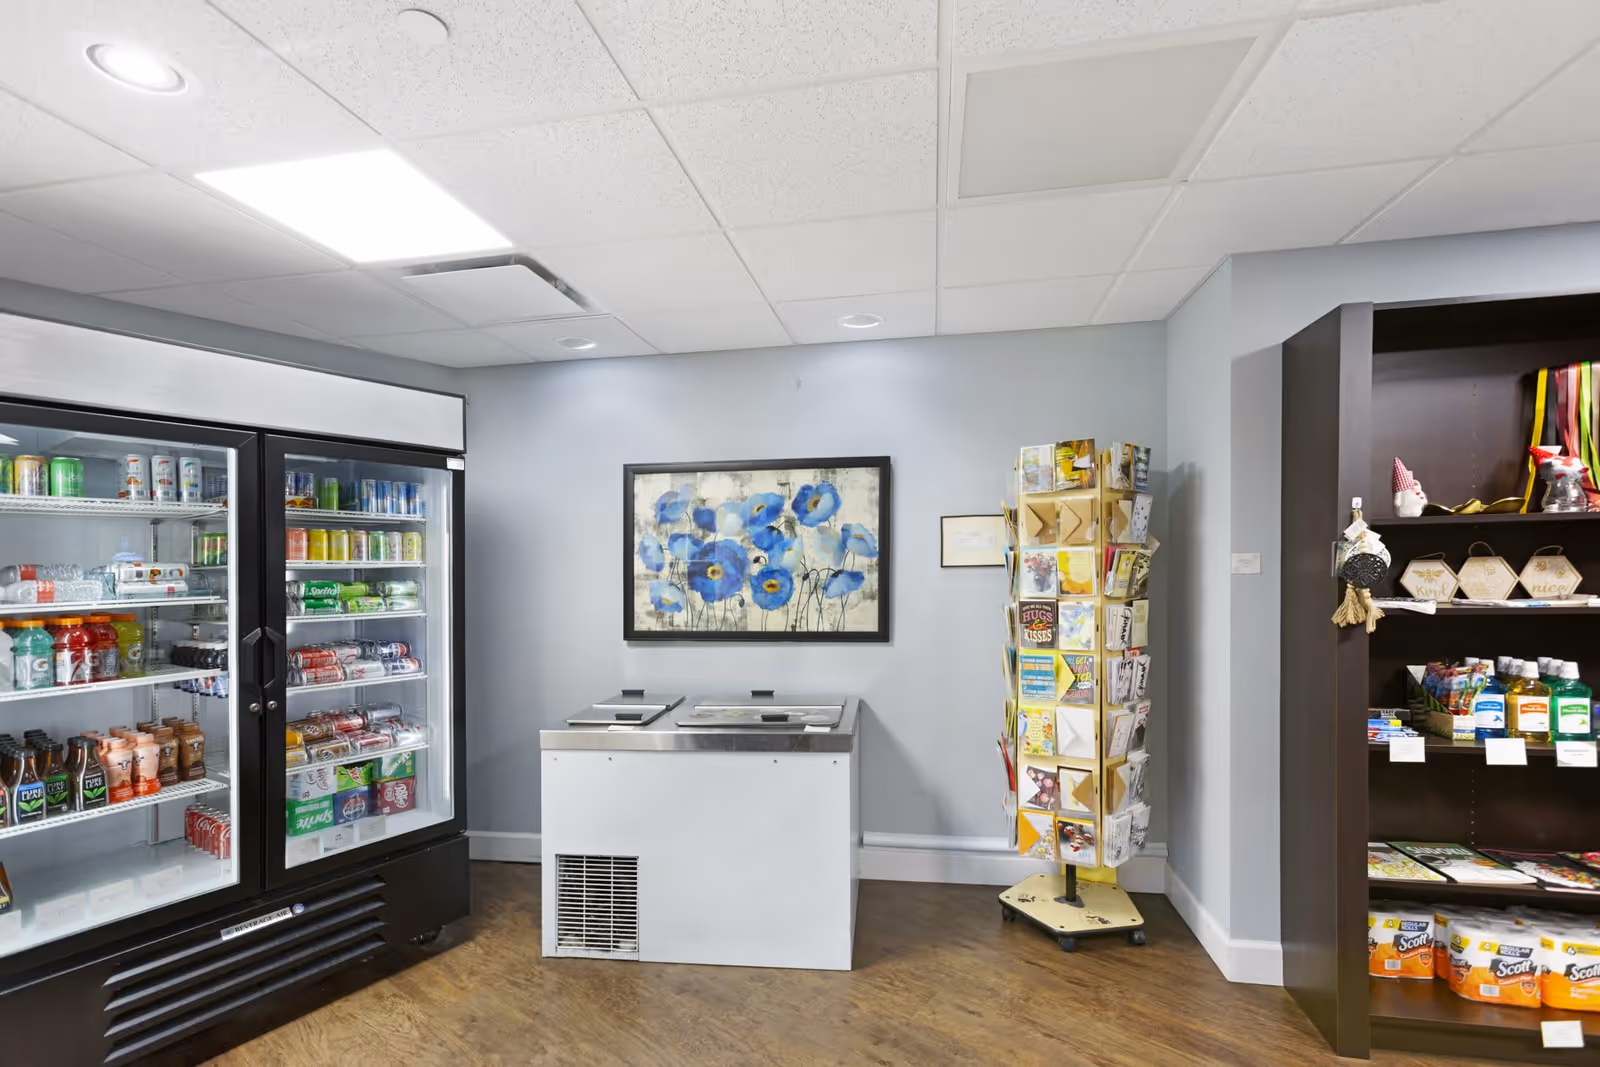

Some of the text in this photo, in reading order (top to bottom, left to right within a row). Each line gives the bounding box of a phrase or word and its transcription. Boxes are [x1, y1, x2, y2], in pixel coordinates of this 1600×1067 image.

[310, 587, 337, 596] Sprite
[1023, 610, 1053, 623] HUGS
[1033, 619, 1047, 630] &
[1024, 629, 1052, 643] KISSES
[85, 777, 102, 785] PURE
[22, 788, 43, 796] PURE
[296, 809, 333, 829] Sprite
[1398, 933, 1427, 951] Scott
[1496, 960, 1532, 977] Scott
